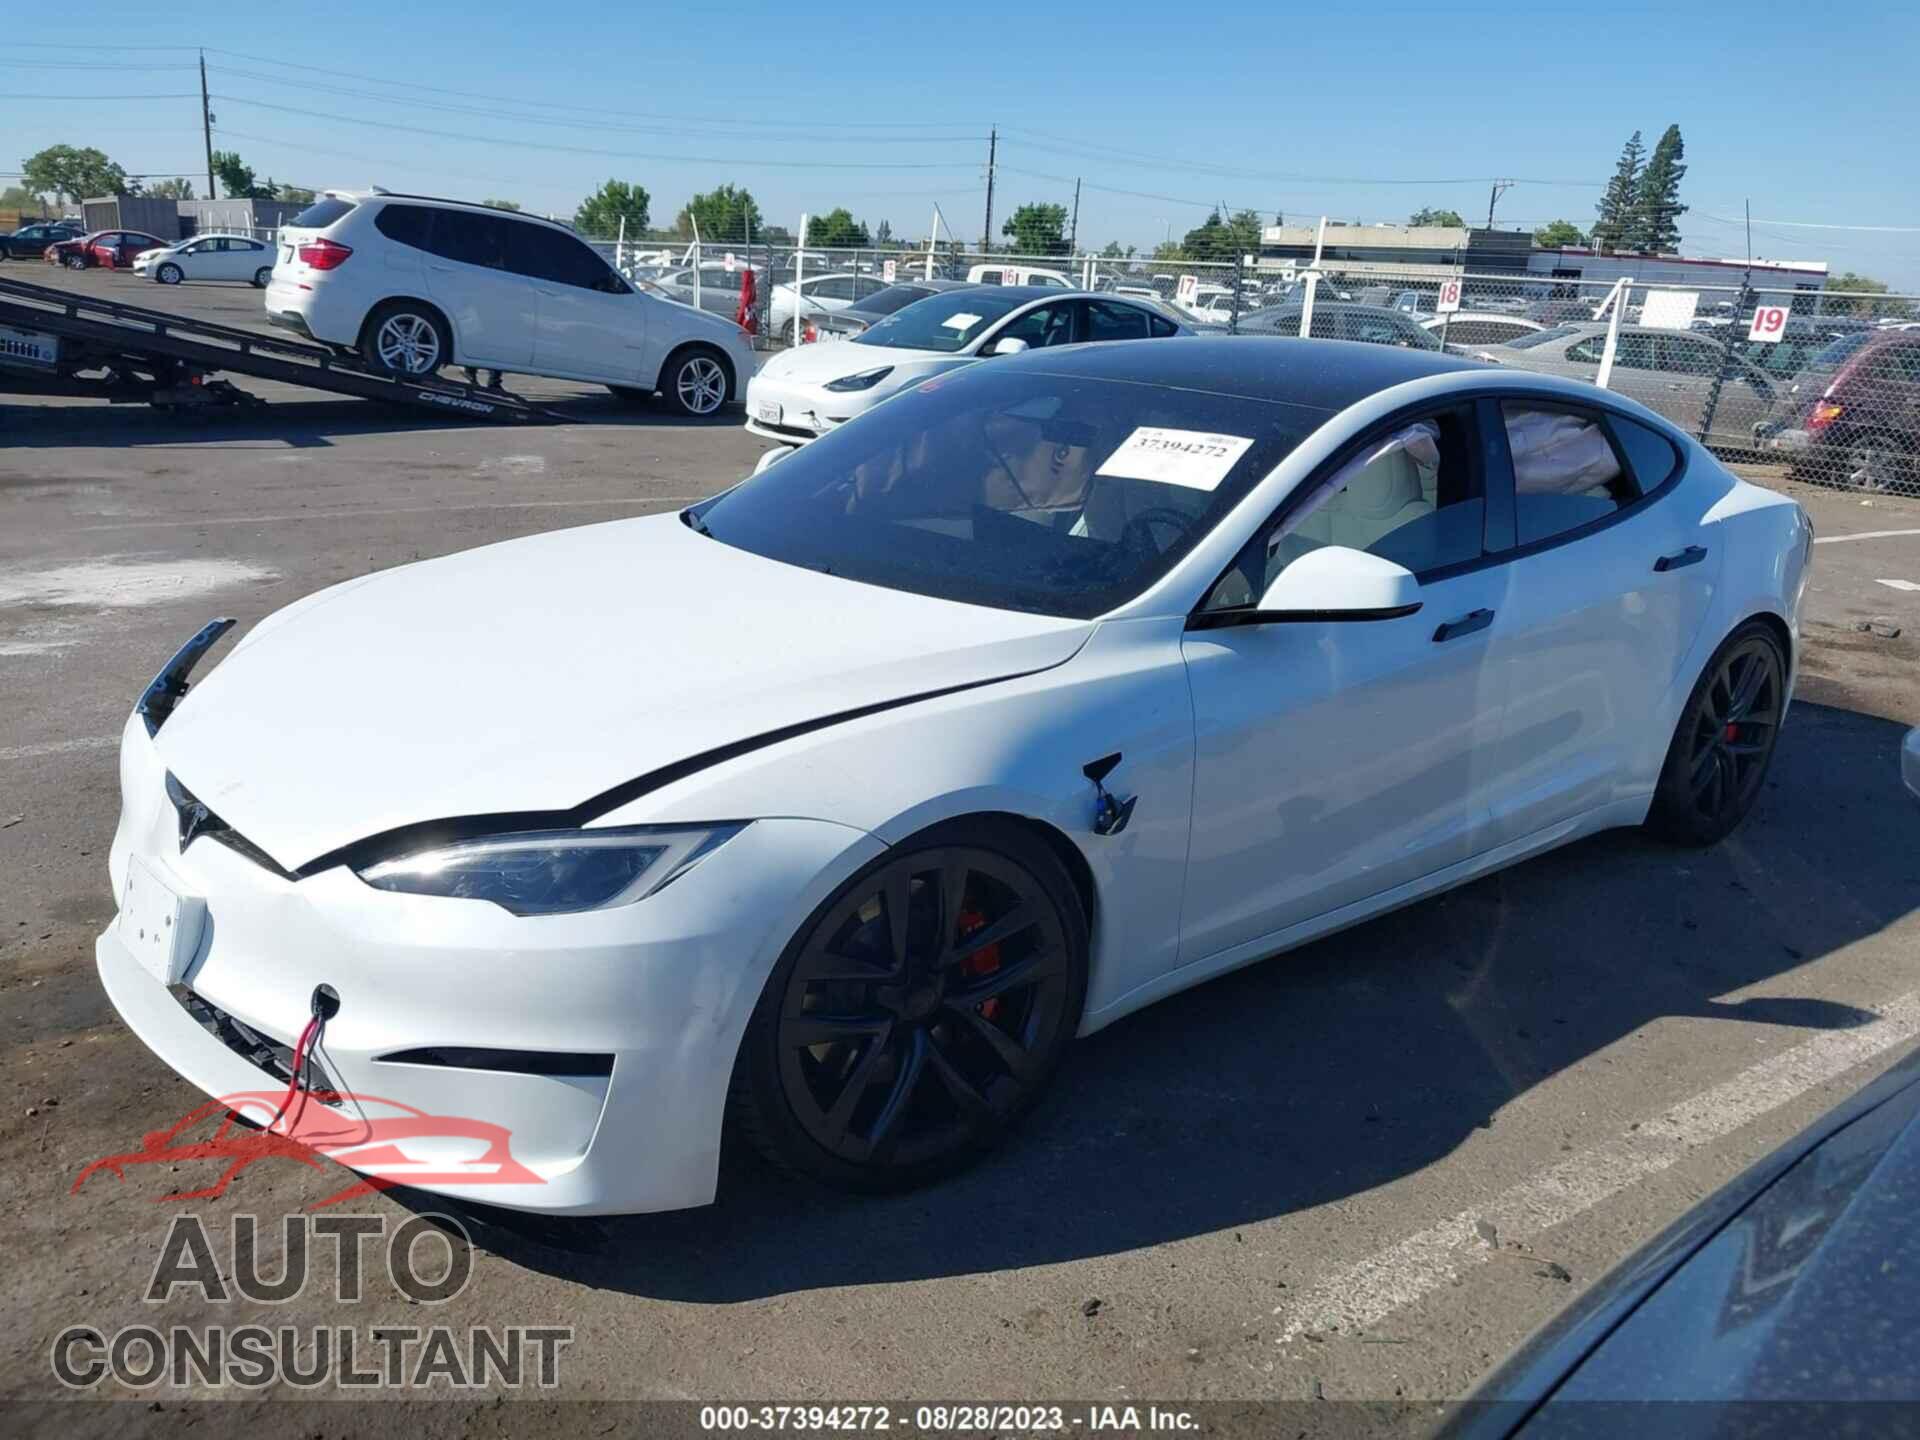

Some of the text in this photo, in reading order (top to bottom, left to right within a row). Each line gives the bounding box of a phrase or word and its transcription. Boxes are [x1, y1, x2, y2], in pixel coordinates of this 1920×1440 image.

[1003, 268, 1015, 284] 16
[1179, 277, 1195, 294] 17
[1440, 284, 1458, 304] 18
[1754, 309, 1784, 332] 19
[1134, 437, 1228, 457] 37394272
